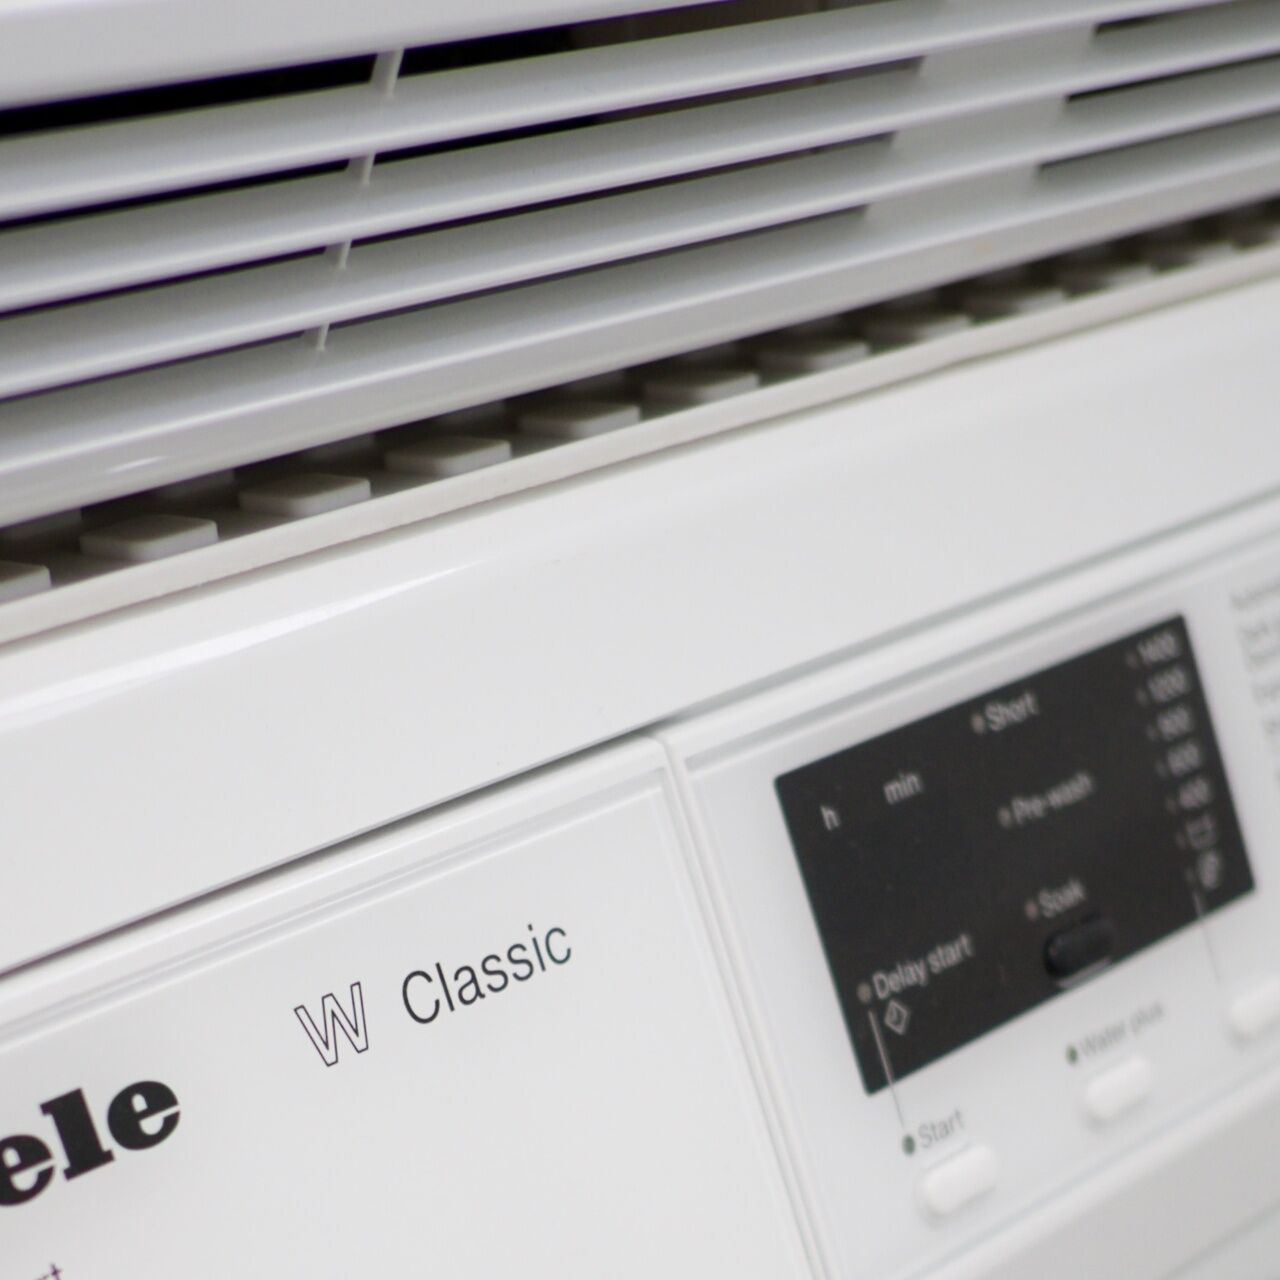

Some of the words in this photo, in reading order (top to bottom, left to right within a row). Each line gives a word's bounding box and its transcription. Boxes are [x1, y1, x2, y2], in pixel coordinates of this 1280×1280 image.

[985, 691, 1039, 732] Short
[883, 773, 923, 804] min
[1012, 772, 1094, 825] Pre-wash
[821, 806, 841, 831] h
[1039, 879, 1086, 918] Soak
[873, 958, 929, 999] Delay
[927, 933, 974, 974] start
[293, 981, 371, 1068] W
[401, 922, 573, 1025] Classic
[918, 1108, 965, 1149] Start
